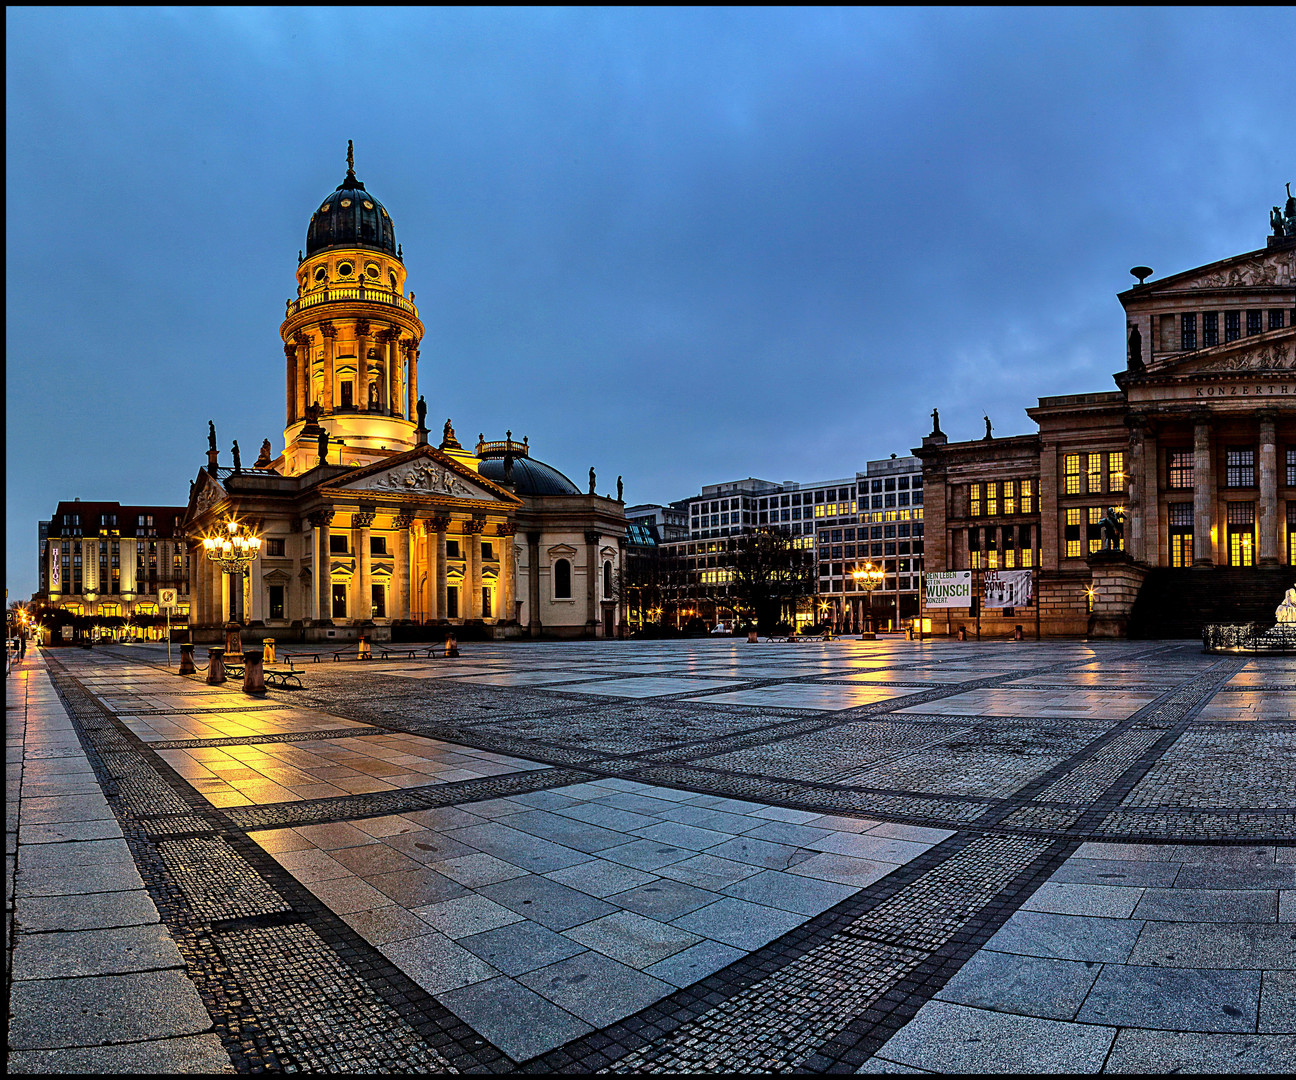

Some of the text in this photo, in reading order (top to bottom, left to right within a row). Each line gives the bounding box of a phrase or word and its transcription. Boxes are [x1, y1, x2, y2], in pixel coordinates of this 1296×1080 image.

[940, 571, 957, 579] LEBEN
[984, 571, 1001, 581] WEL
[926, 584, 969, 597] WUNSCH
